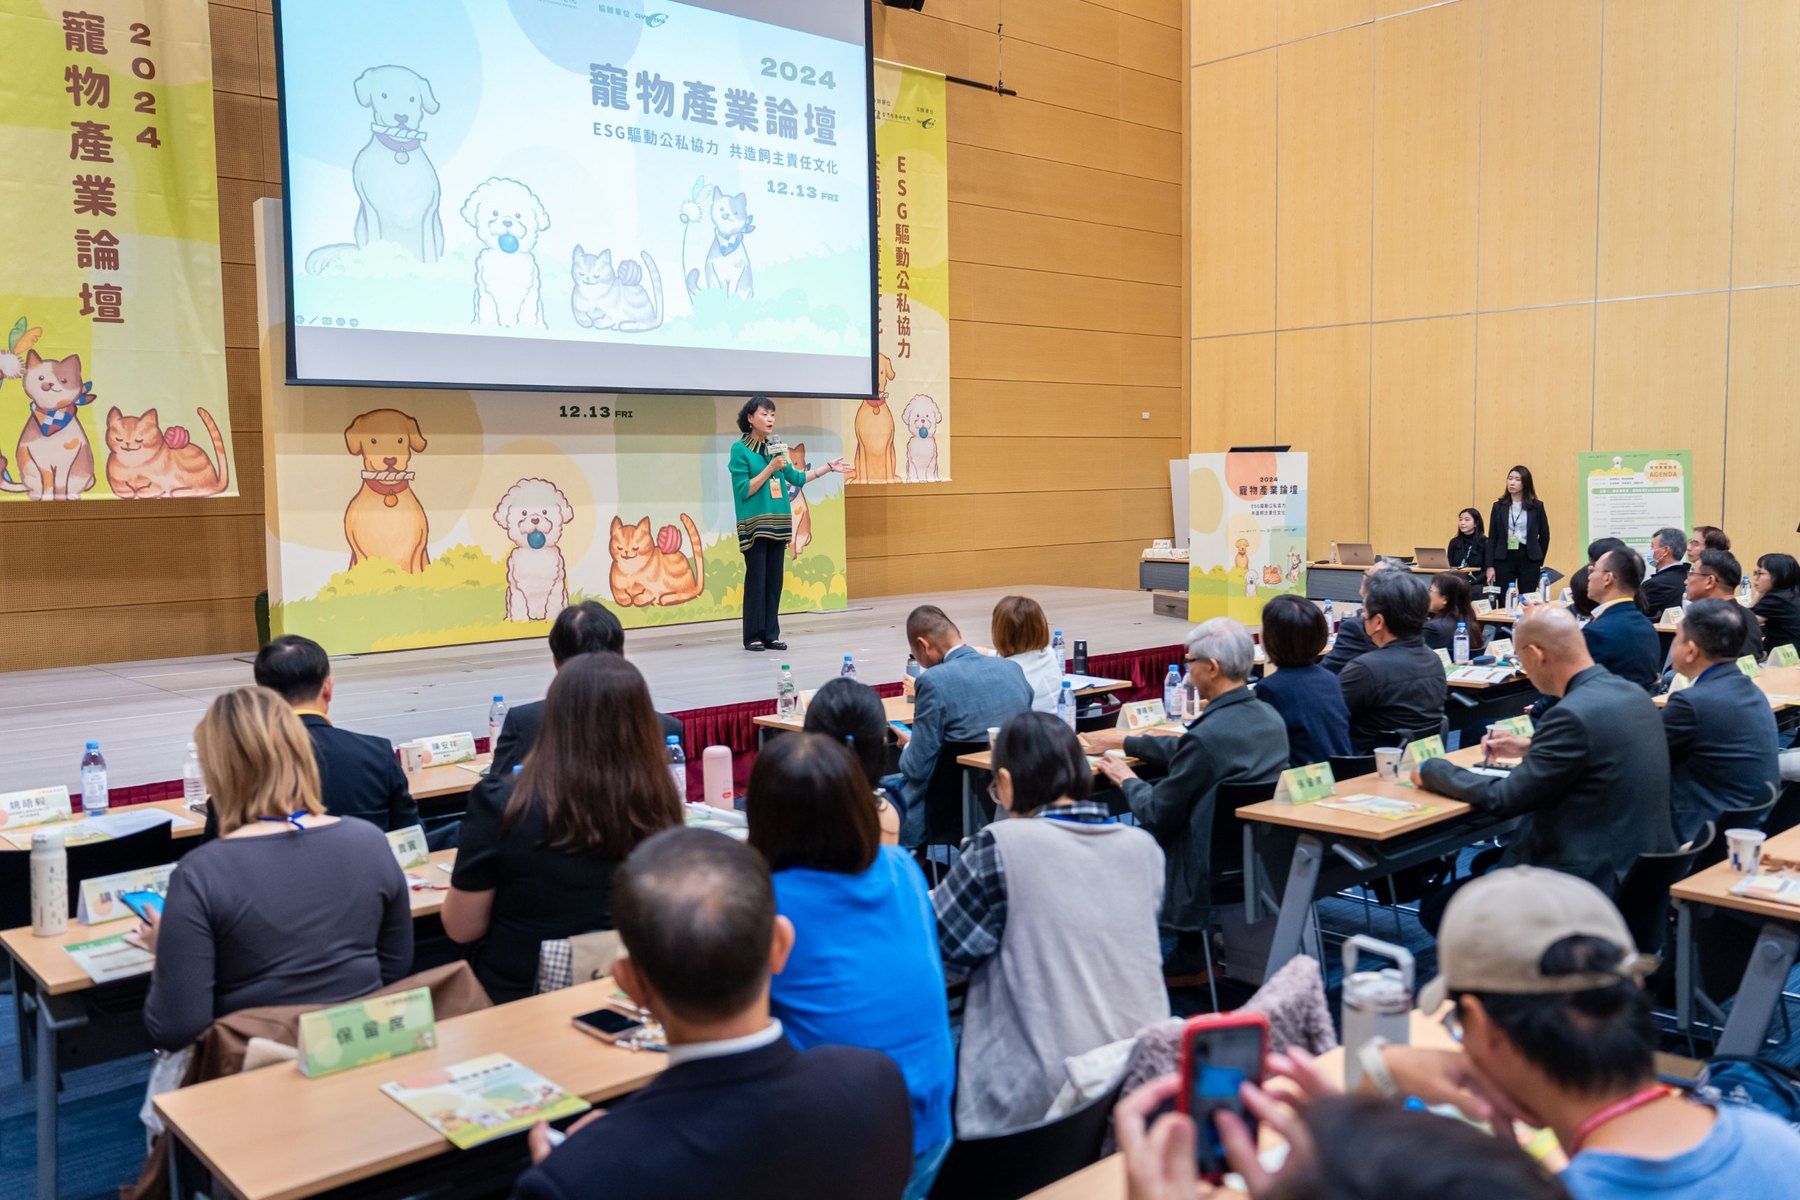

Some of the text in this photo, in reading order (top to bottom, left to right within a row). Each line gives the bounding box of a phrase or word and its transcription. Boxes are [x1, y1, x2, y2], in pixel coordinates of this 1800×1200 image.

[128, 22, 161, 149] 2024
[589, 62, 837, 147] 寵物產業論壇
[760, 57, 836, 90] 2024
[62, 9, 125, 325] 寵物產業論壇
[593, 121, 839, 175] ESG驅動公私協力 共造飼主責任文化
[766, 179, 839, 203] 12.13 FRI
[895, 155, 911, 359] ESG驅動公私協力
[560, 405, 633, 418] 12.13 FRI
